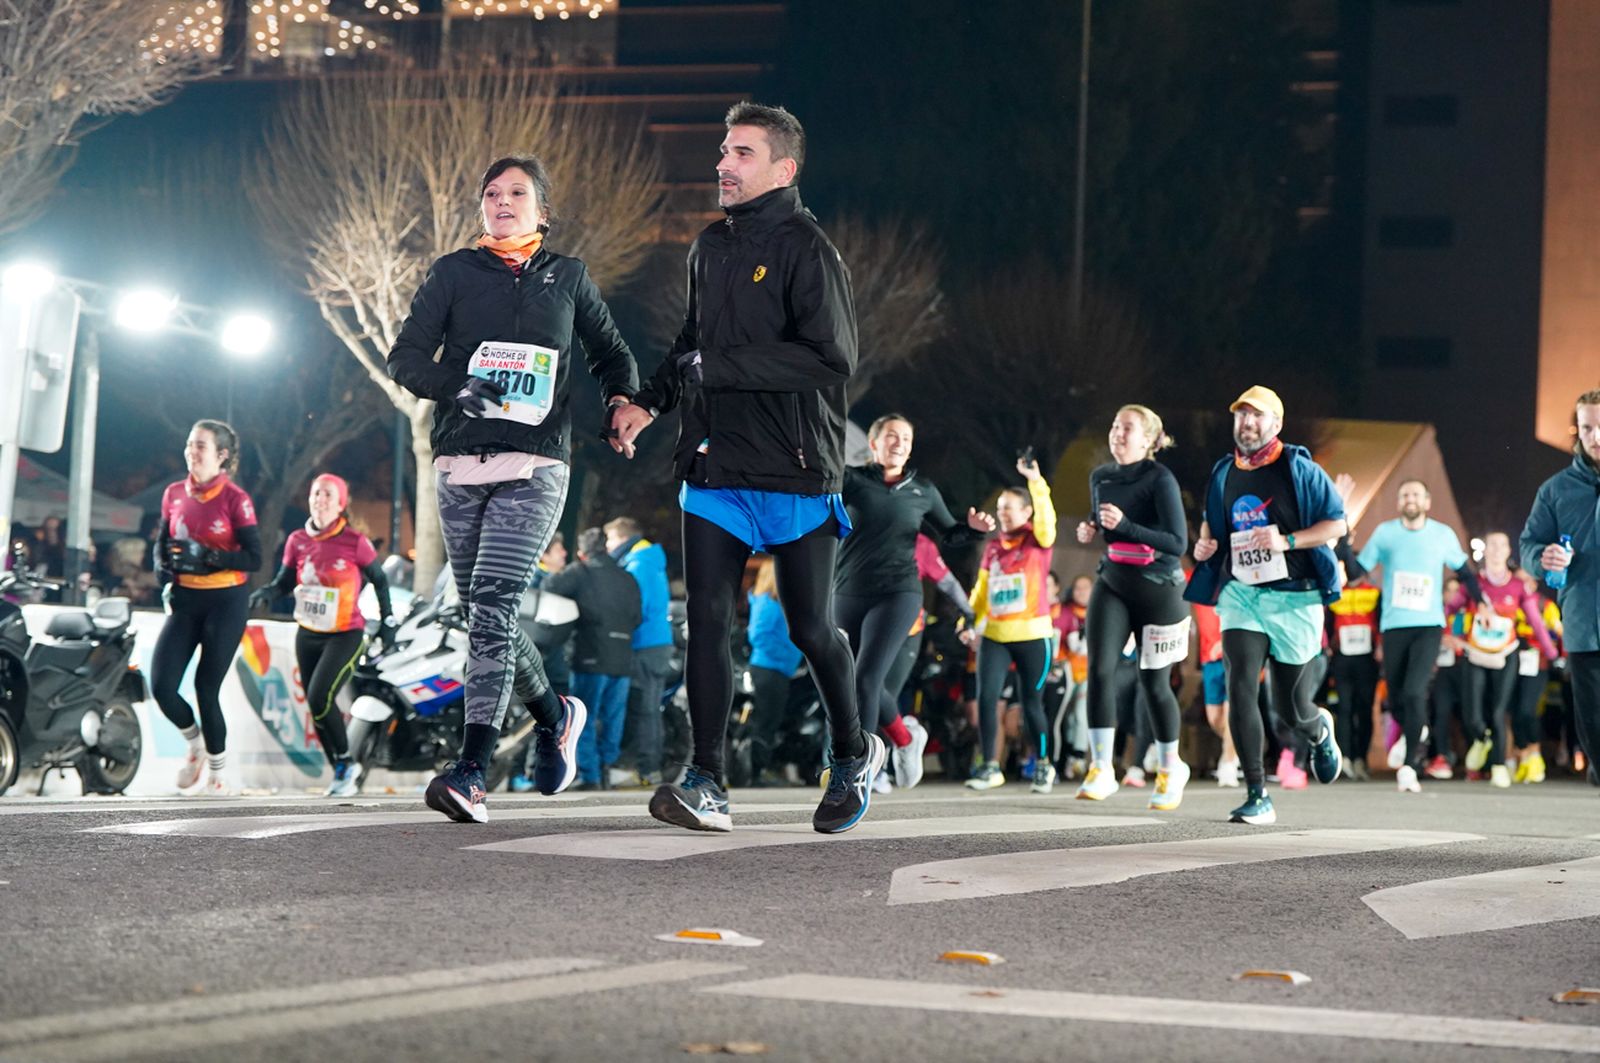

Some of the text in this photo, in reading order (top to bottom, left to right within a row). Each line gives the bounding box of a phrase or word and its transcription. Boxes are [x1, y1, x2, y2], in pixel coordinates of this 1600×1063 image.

[489, 350, 516, 360] NOCHE
[479, 359, 496, 368] SAN
[1233, 510, 1268, 521] NASA
[1238, 548, 1272, 567] 4333
